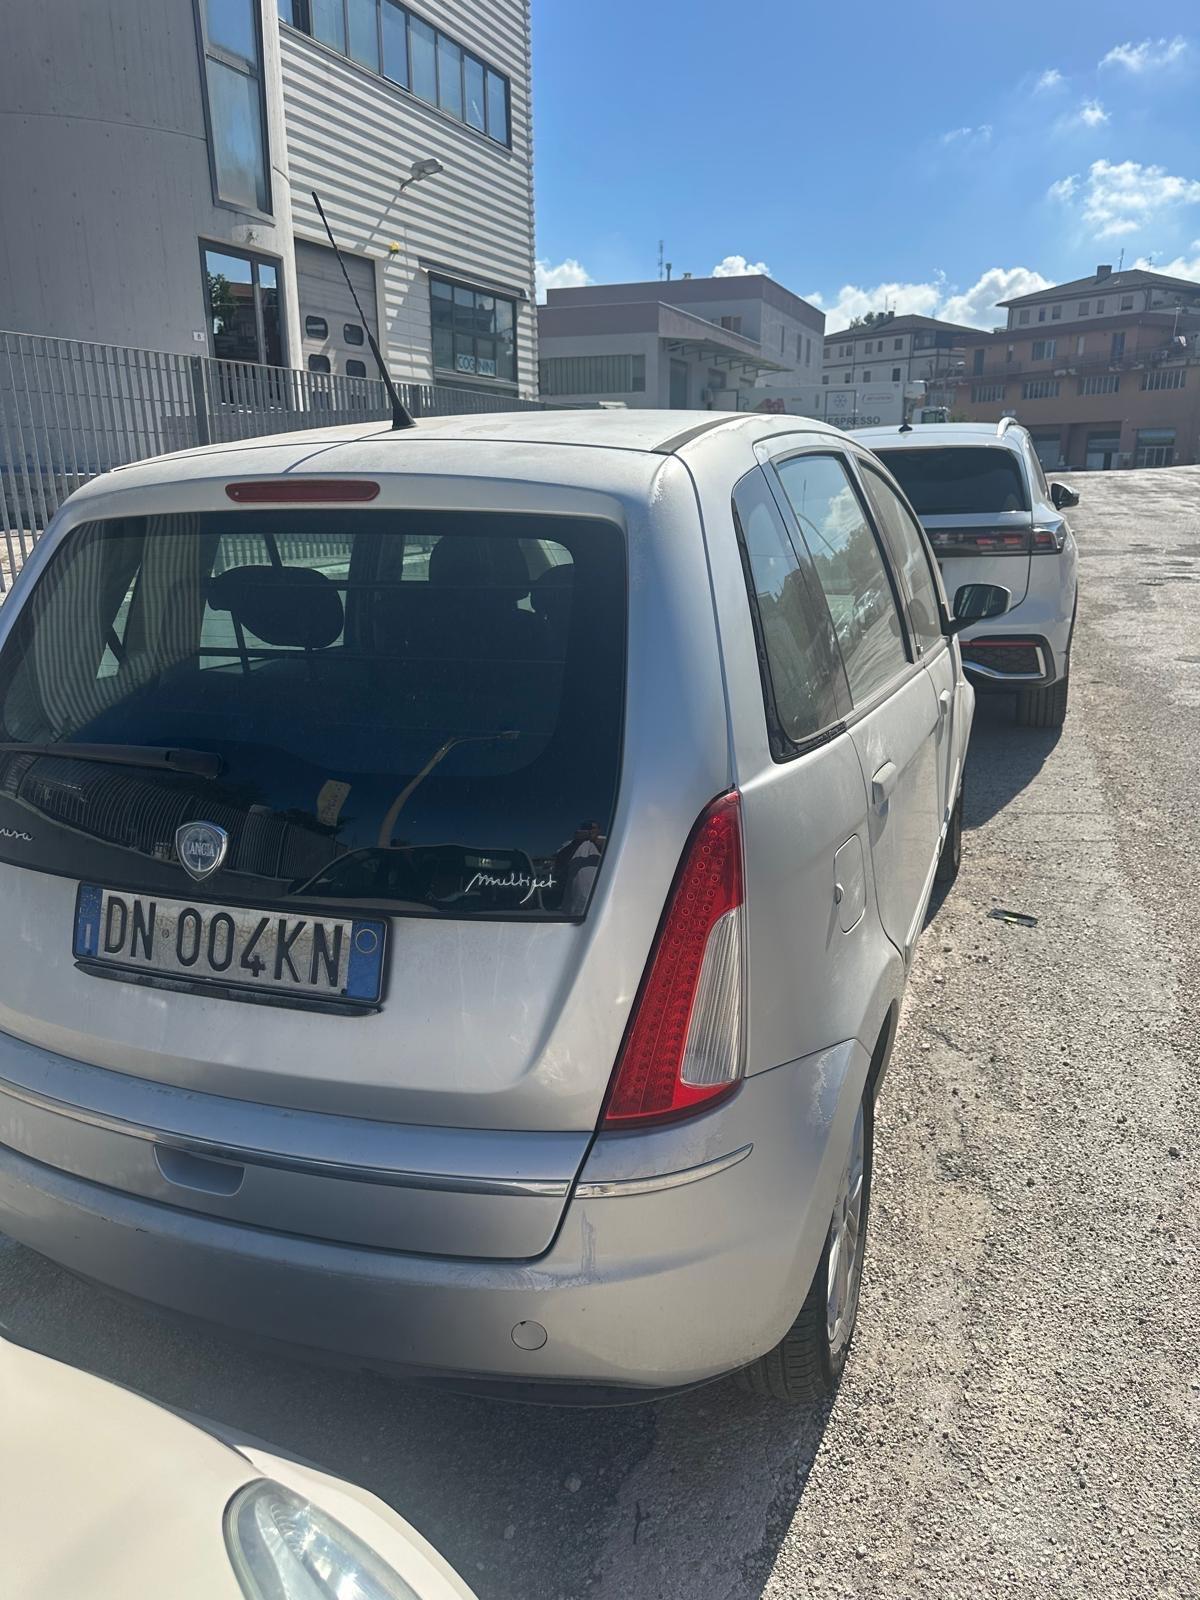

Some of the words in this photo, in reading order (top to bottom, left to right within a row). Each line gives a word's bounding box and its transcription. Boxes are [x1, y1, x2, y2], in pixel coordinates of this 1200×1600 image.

[827, 416, 881, 426] ESPRESSO
[0, 828, 33, 841] usa
[185, 841, 215, 857] LANCIA
[103, 895, 157, 961] DN
[175, 907, 344, 988] 004KN
